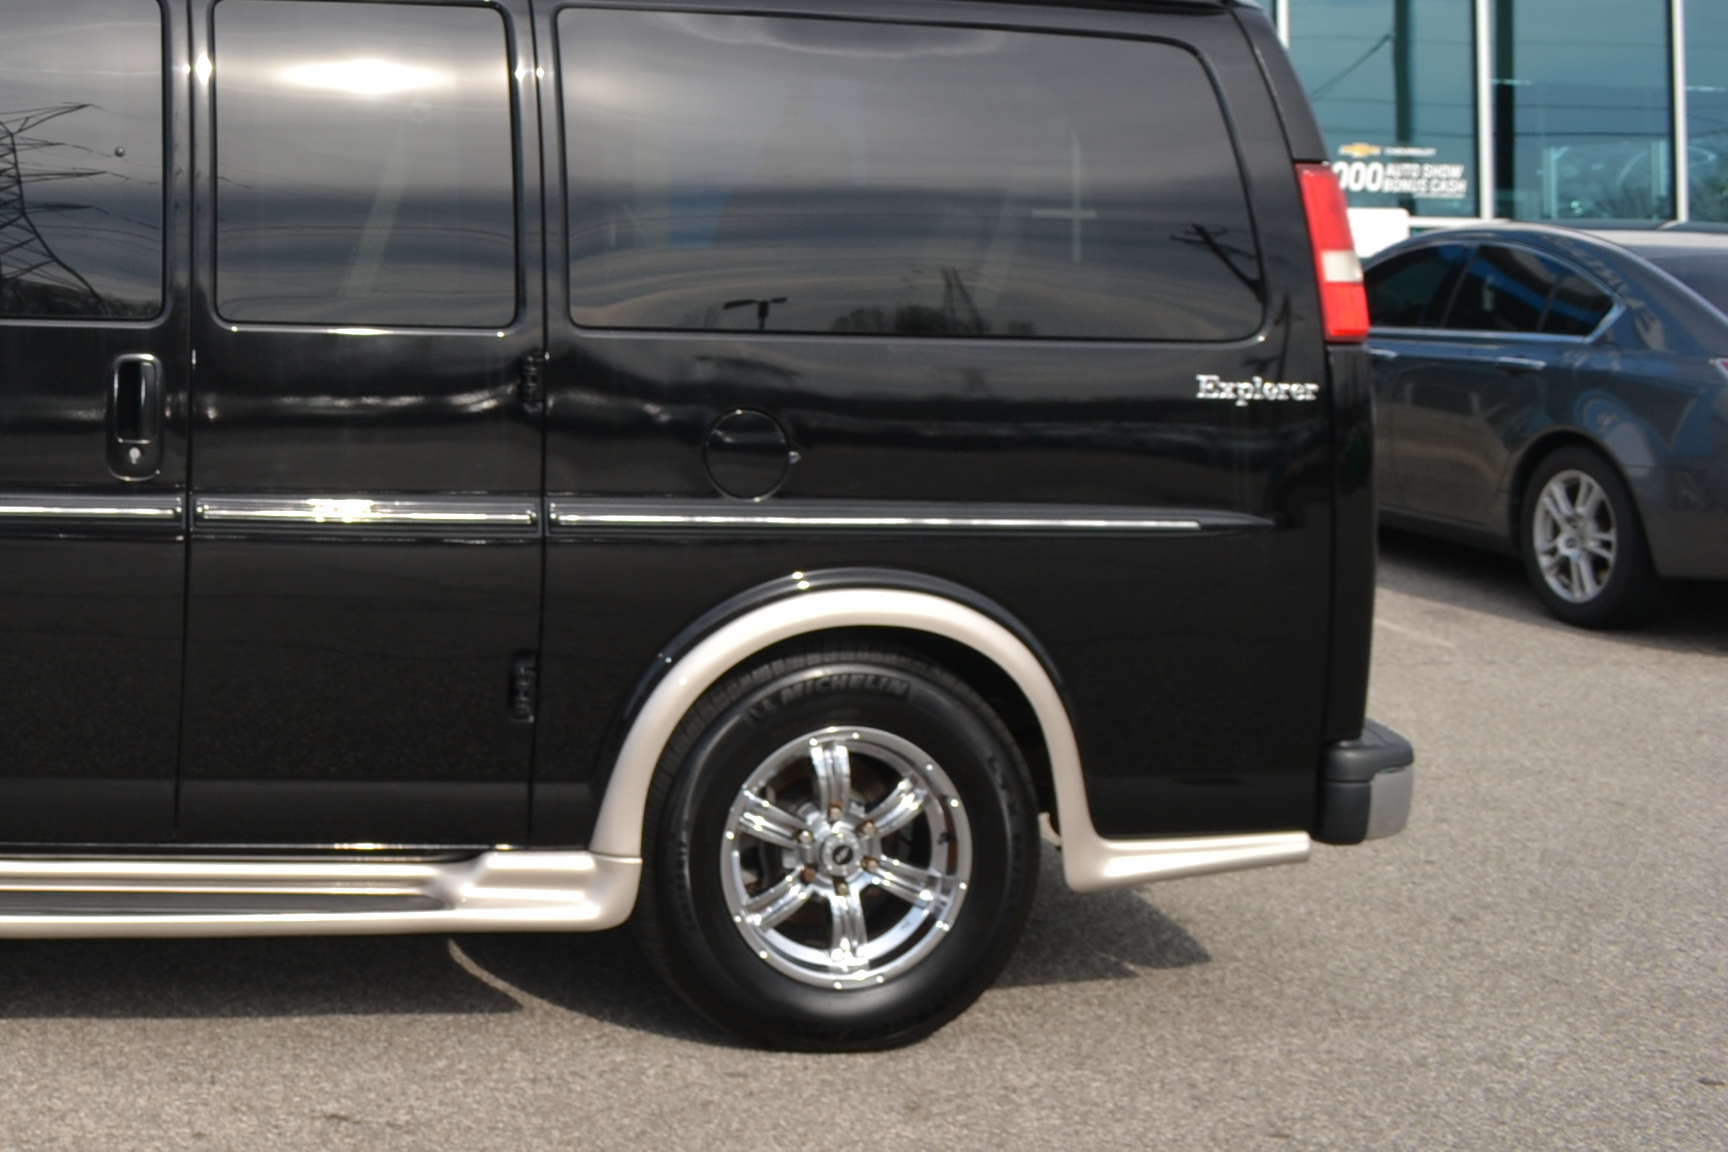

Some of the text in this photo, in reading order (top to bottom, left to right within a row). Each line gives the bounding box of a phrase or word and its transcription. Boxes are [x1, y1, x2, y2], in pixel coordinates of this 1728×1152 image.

[1385, 163, 1465, 179] AUTO SHOW
[1383, 178, 1467, 193] BONUS CASH
[1195, 374, 1320, 407] Explorer
[780, 674, 910, 705] MICHELIN
